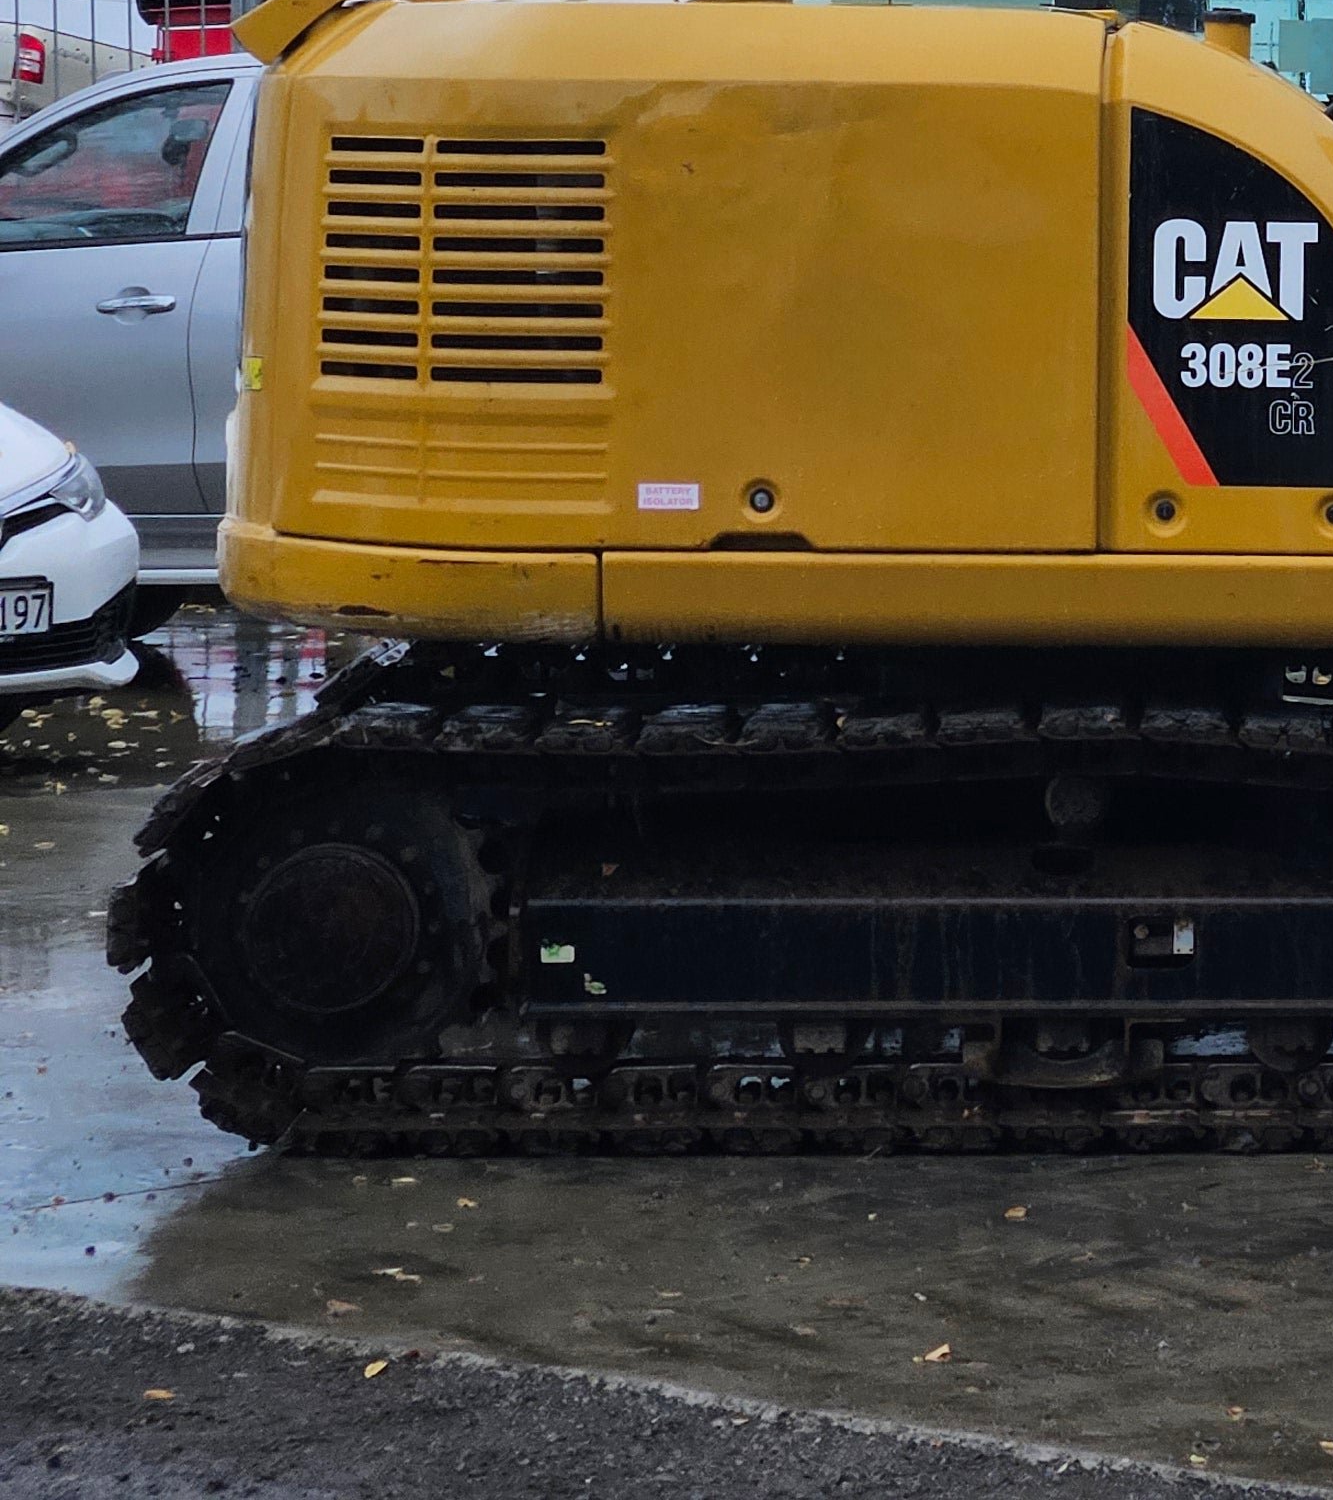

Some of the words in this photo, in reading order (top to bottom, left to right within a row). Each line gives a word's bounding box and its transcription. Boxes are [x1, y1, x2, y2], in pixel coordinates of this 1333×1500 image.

[1152, 218, 1319, 321] CAT
[1268, 399, 1316, 435] CR
[643, 497, 694, 506] ISOLATOR
[645, 486, 692, 495] BATTERY
[0, 593, 46, 631] 197
